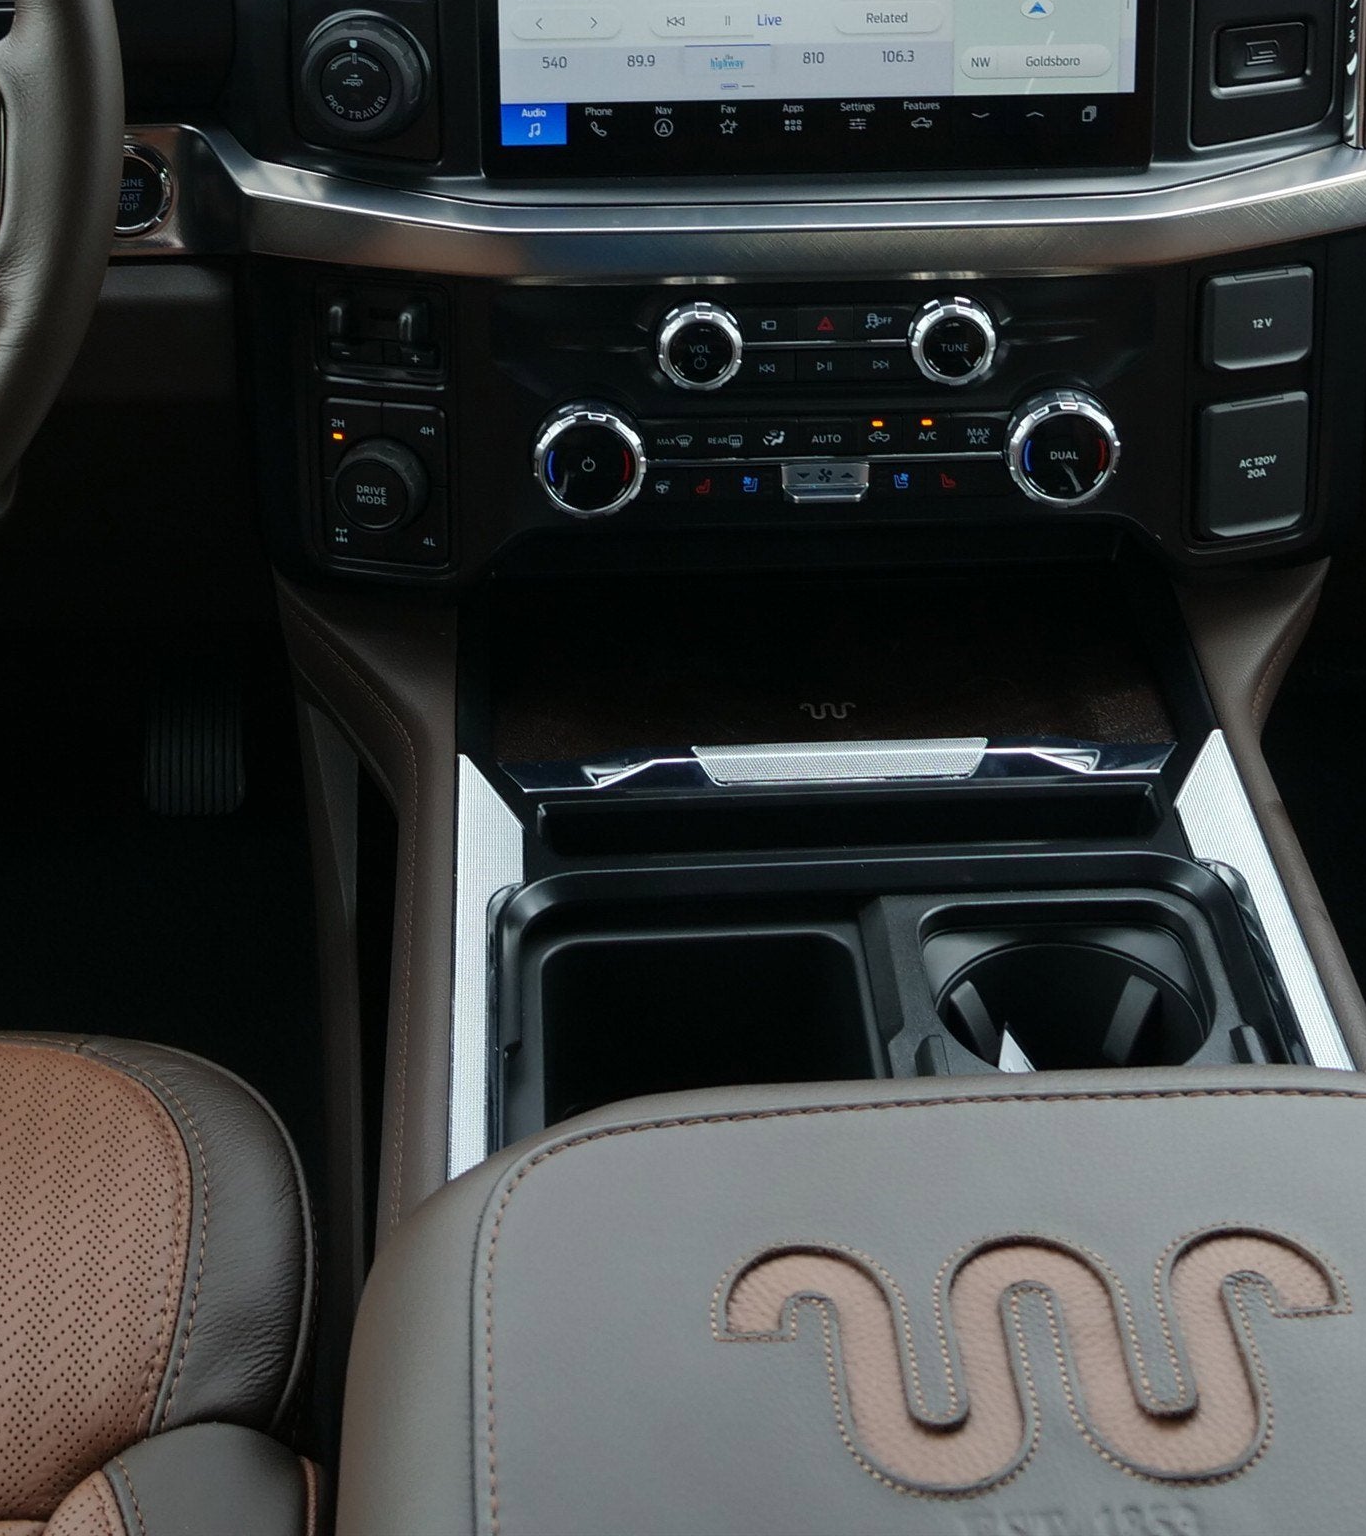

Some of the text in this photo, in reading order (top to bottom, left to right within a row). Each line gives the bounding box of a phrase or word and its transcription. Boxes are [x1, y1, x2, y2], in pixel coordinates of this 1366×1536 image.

[757, 14, 783, 26] Live
[866, 12, 909, 24] Related
[627, 55, 656, 68] 89.9
[802, 51, 825, 65] 810
[882, 50, 915, 63] 106.3
[1026, 56, 1080, 67] Goldsboro
[542, 56, 568, 69] 540
[970, 57, 991, 68] NW
[325, 94, 388, 120] PRO TRAILER
[585, 107, 613, 116] Phone
[655, 106, 673, 115] Nav
[720, 104, 737, 114] Fav
[782, 103, 805, 114] Apps
[840, 102, 876, 113] Settings
[903, 101, 941, 111] Features
[521, 107, 547, 117] Audio
[877, 316, 893, 325] OFF
[1252, 318, 1273, 329] 12 V
[689, 344, 711, 353] VOL
[940, 343, 970, 352] TUNE
[330, 418, 346, 428] 2H
[419, 425, 435, 437] 4H
[918, 431, 937, 441] A/C
[966, 427, 991, 437] MAX
[656, 437, 676, 445] MAX
[707, 436, 728, 445] REAR
[811, 434, 843, 444] AUTO
[969, 436, 989, 445] A/C
[1049, 450, 1079, 461] DUAL
[1238, 455, 1277, 469] AC 120V
[1246, 469, 1267, 479] 20A
[355, 484, 388, 496] DRIVE
[355, 494, 388, 506] MODE
[422, 536, 436, 547] 4L
